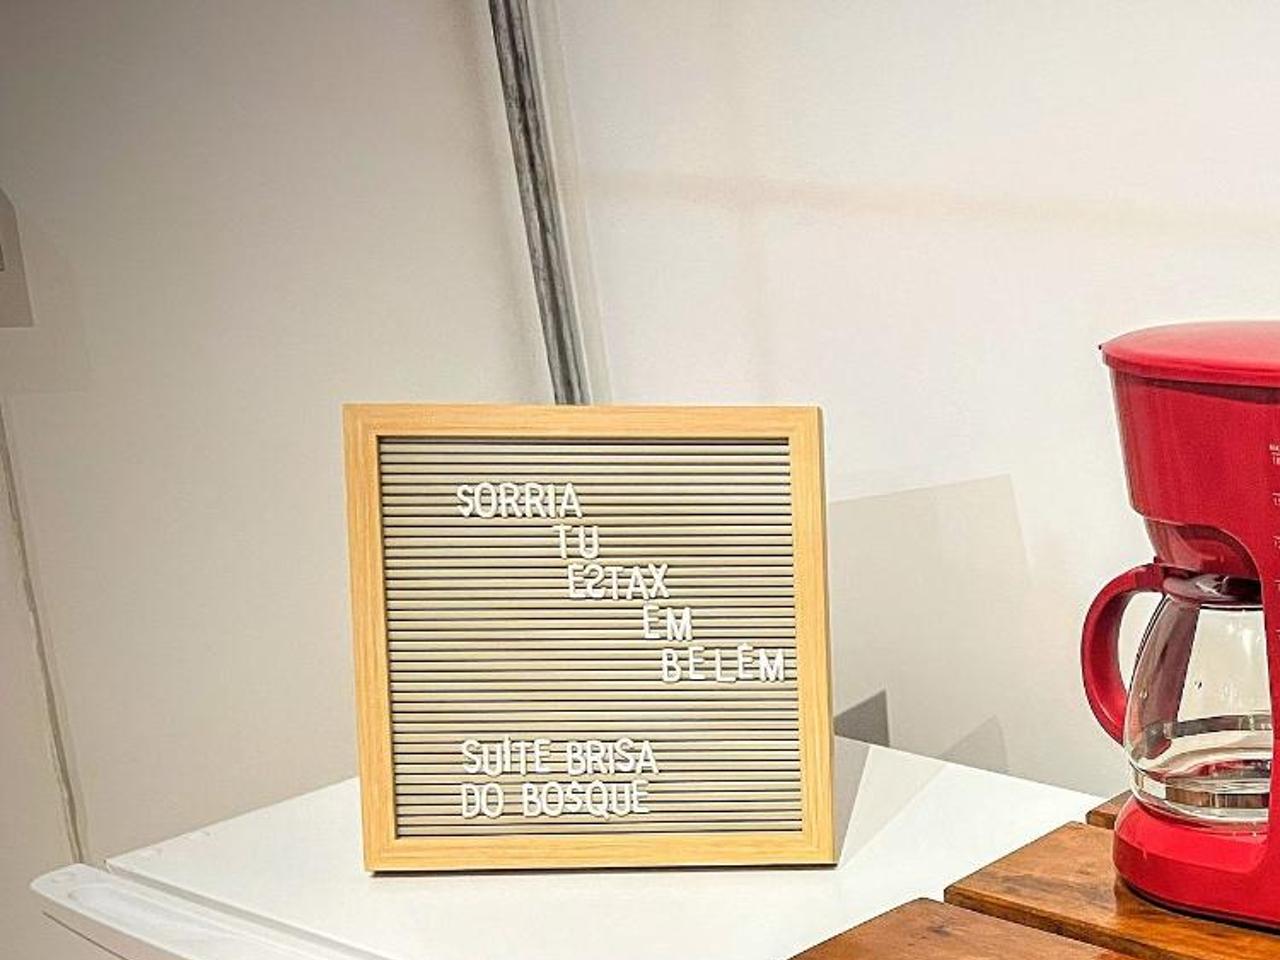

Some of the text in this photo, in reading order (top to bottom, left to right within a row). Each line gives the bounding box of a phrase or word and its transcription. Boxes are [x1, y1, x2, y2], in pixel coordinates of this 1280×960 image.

[456, 482, 583, 518] SORRIA
[552, 523, 600, 560] TU
[643, 603, 693, 641] EM
[566, 738, 660, 776] BRISA
[461, 780, 650, 821] DO BOSQUE
